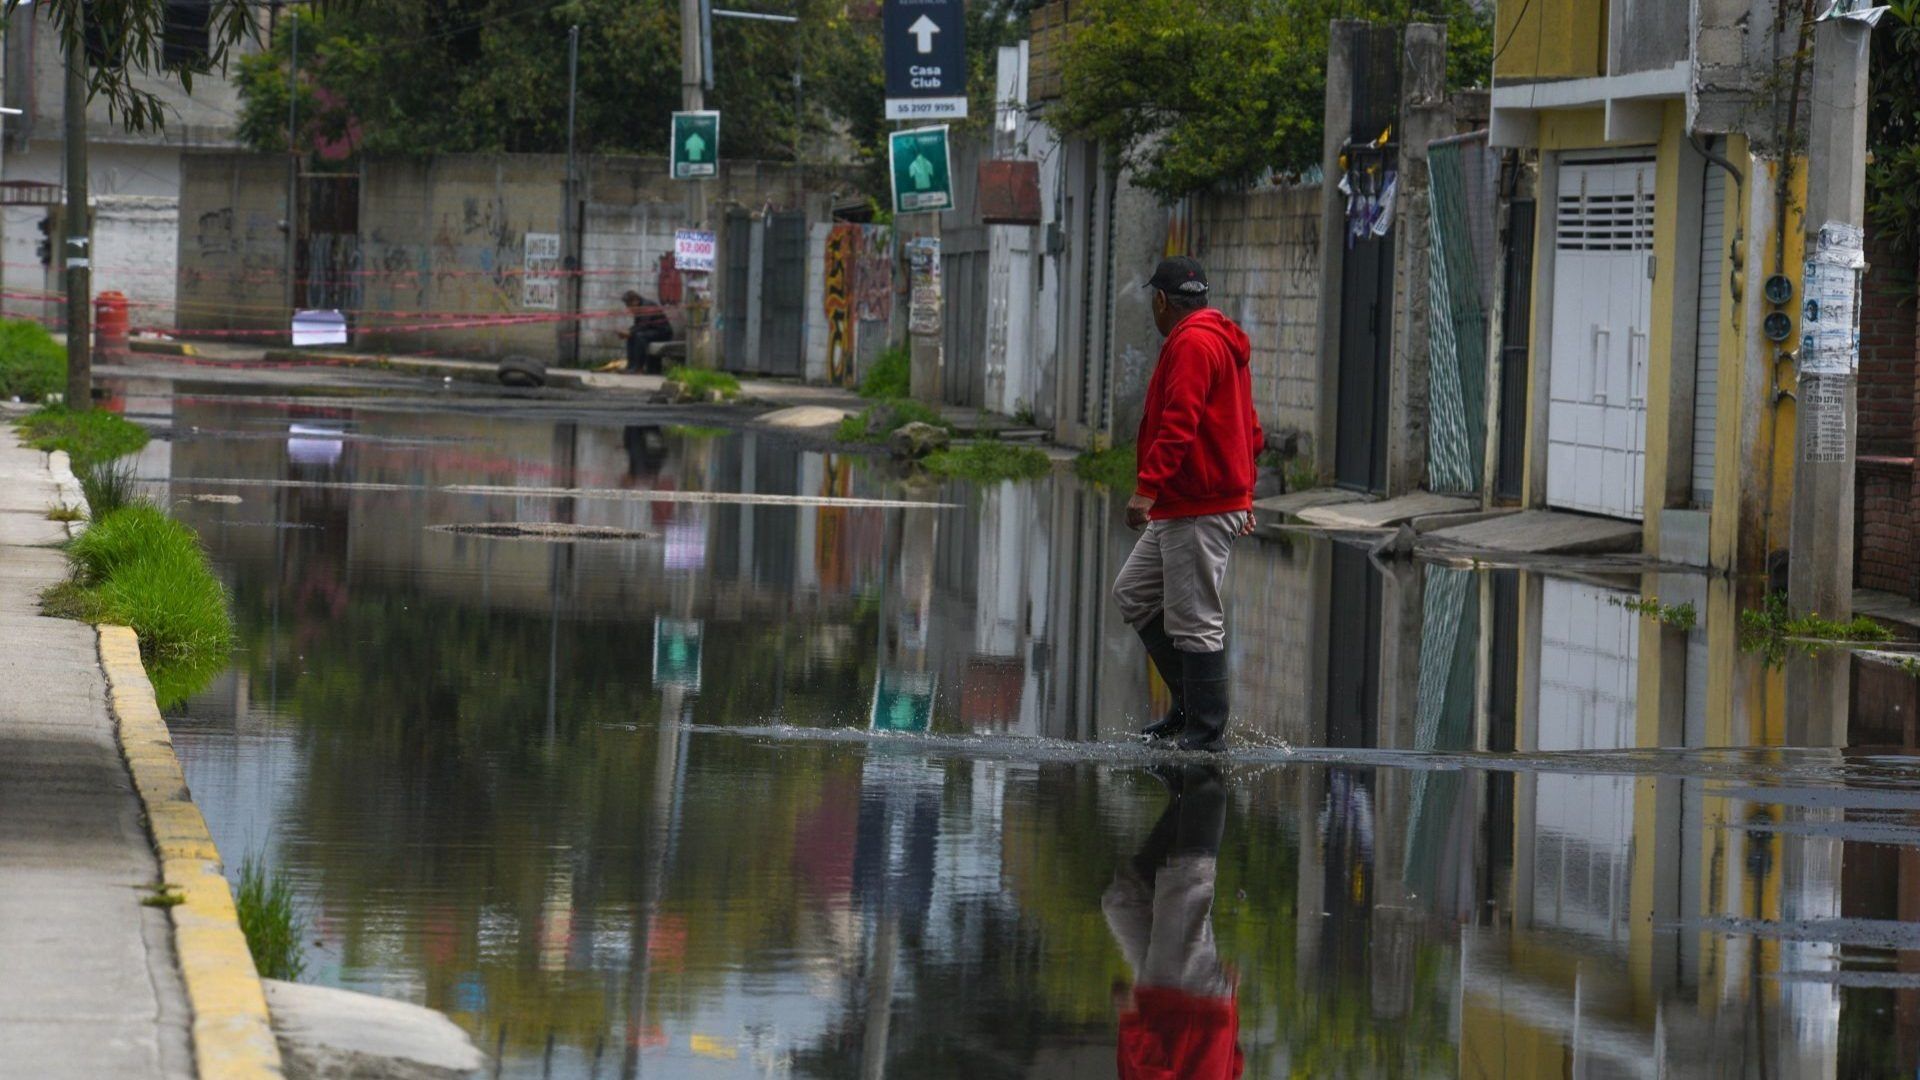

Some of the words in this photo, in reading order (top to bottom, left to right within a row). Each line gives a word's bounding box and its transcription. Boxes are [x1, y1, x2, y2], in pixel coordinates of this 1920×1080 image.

[909, 65, 941, 76] Casa
[911, 77, 941, 88] Club
[898, 104, 909, 112] 55
[911, 103, 932, 112] 2107
[934, 102, 956, 112] 9195
